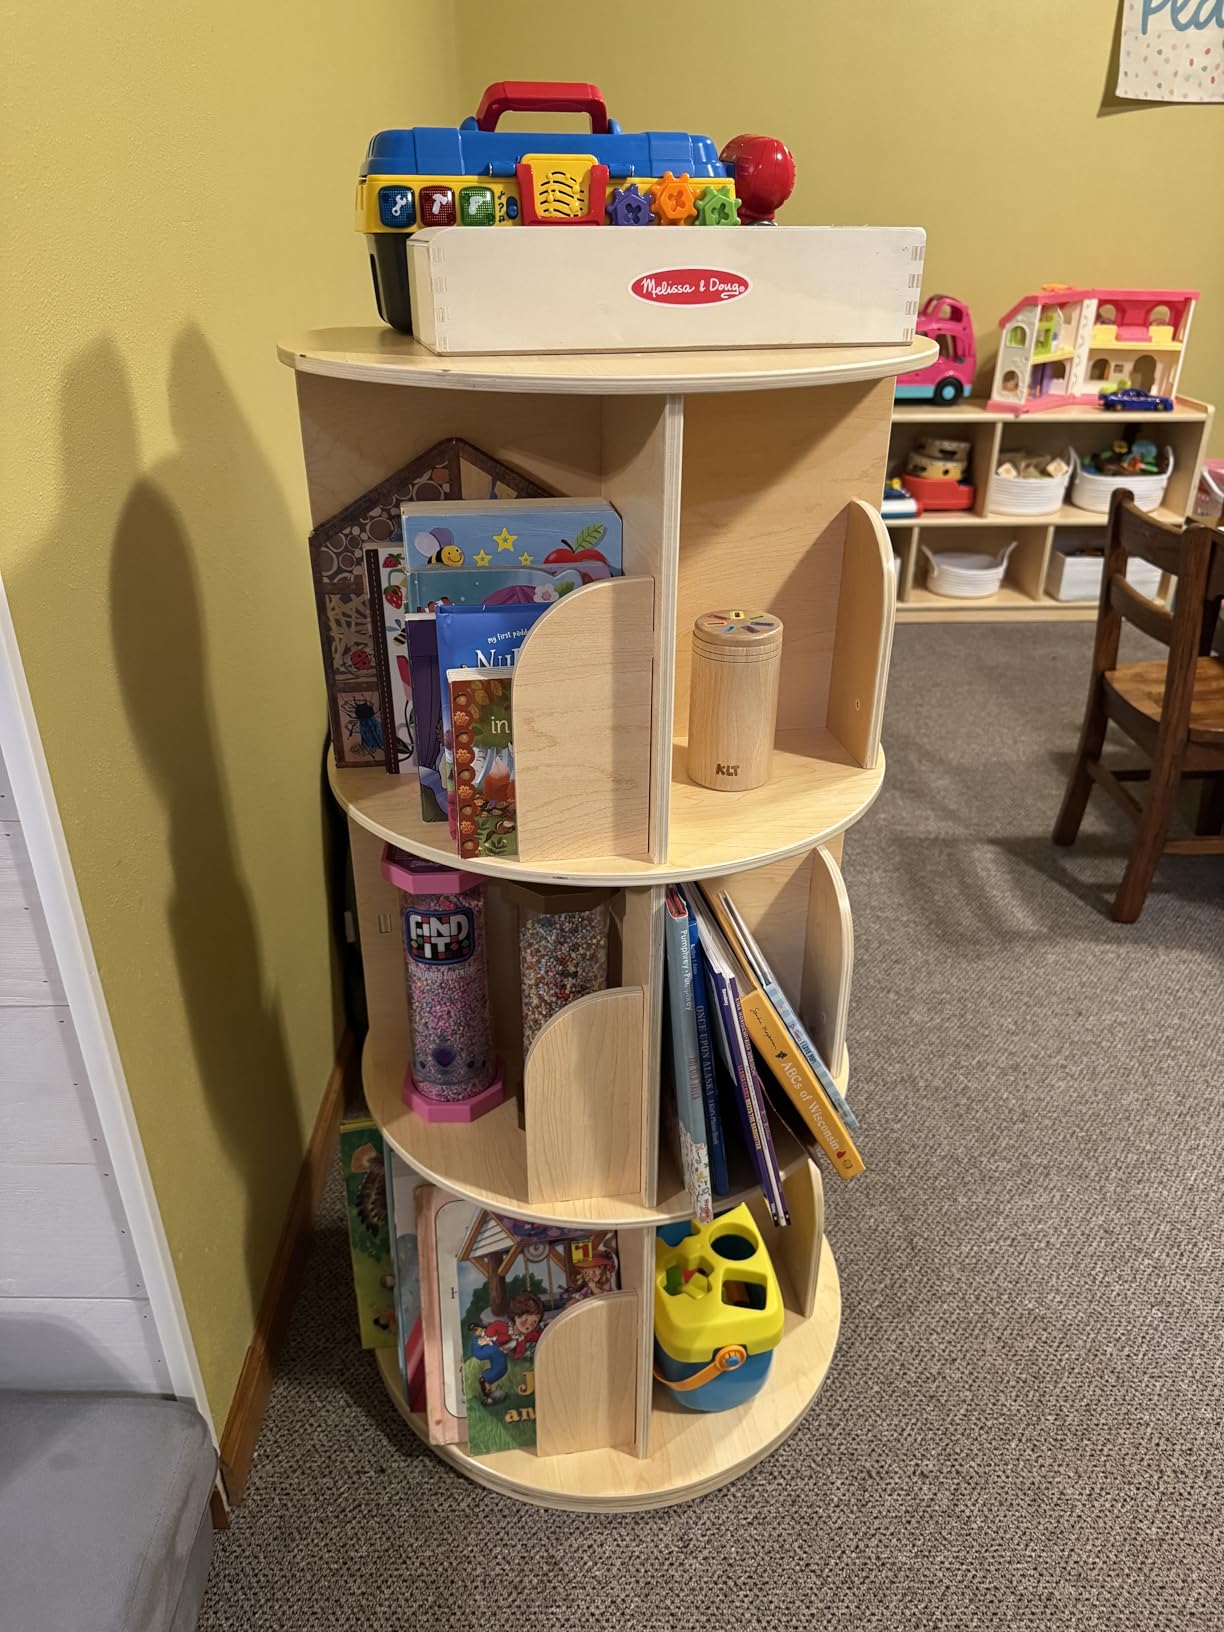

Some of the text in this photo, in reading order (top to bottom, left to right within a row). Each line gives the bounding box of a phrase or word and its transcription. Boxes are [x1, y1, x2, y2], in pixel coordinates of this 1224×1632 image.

[641, 278, 695, 297] Melissa
[699, 280, 706, 292] &
[487, 628, 529, 644] my first padd
[491, 716, 510, 734] in
[716, 763, 740, 777] KLT
[409, 914, 469, 941] FIND
[423, 936, 451, 958] IT
[696, 1005, 714, 1096] ONCE UPON ALASKA
[782, 1061, 840, 1150] ABCs of Wisconsin
[517, 1371, 534, 1396] J
[505, 1408, 536, 1423] an
